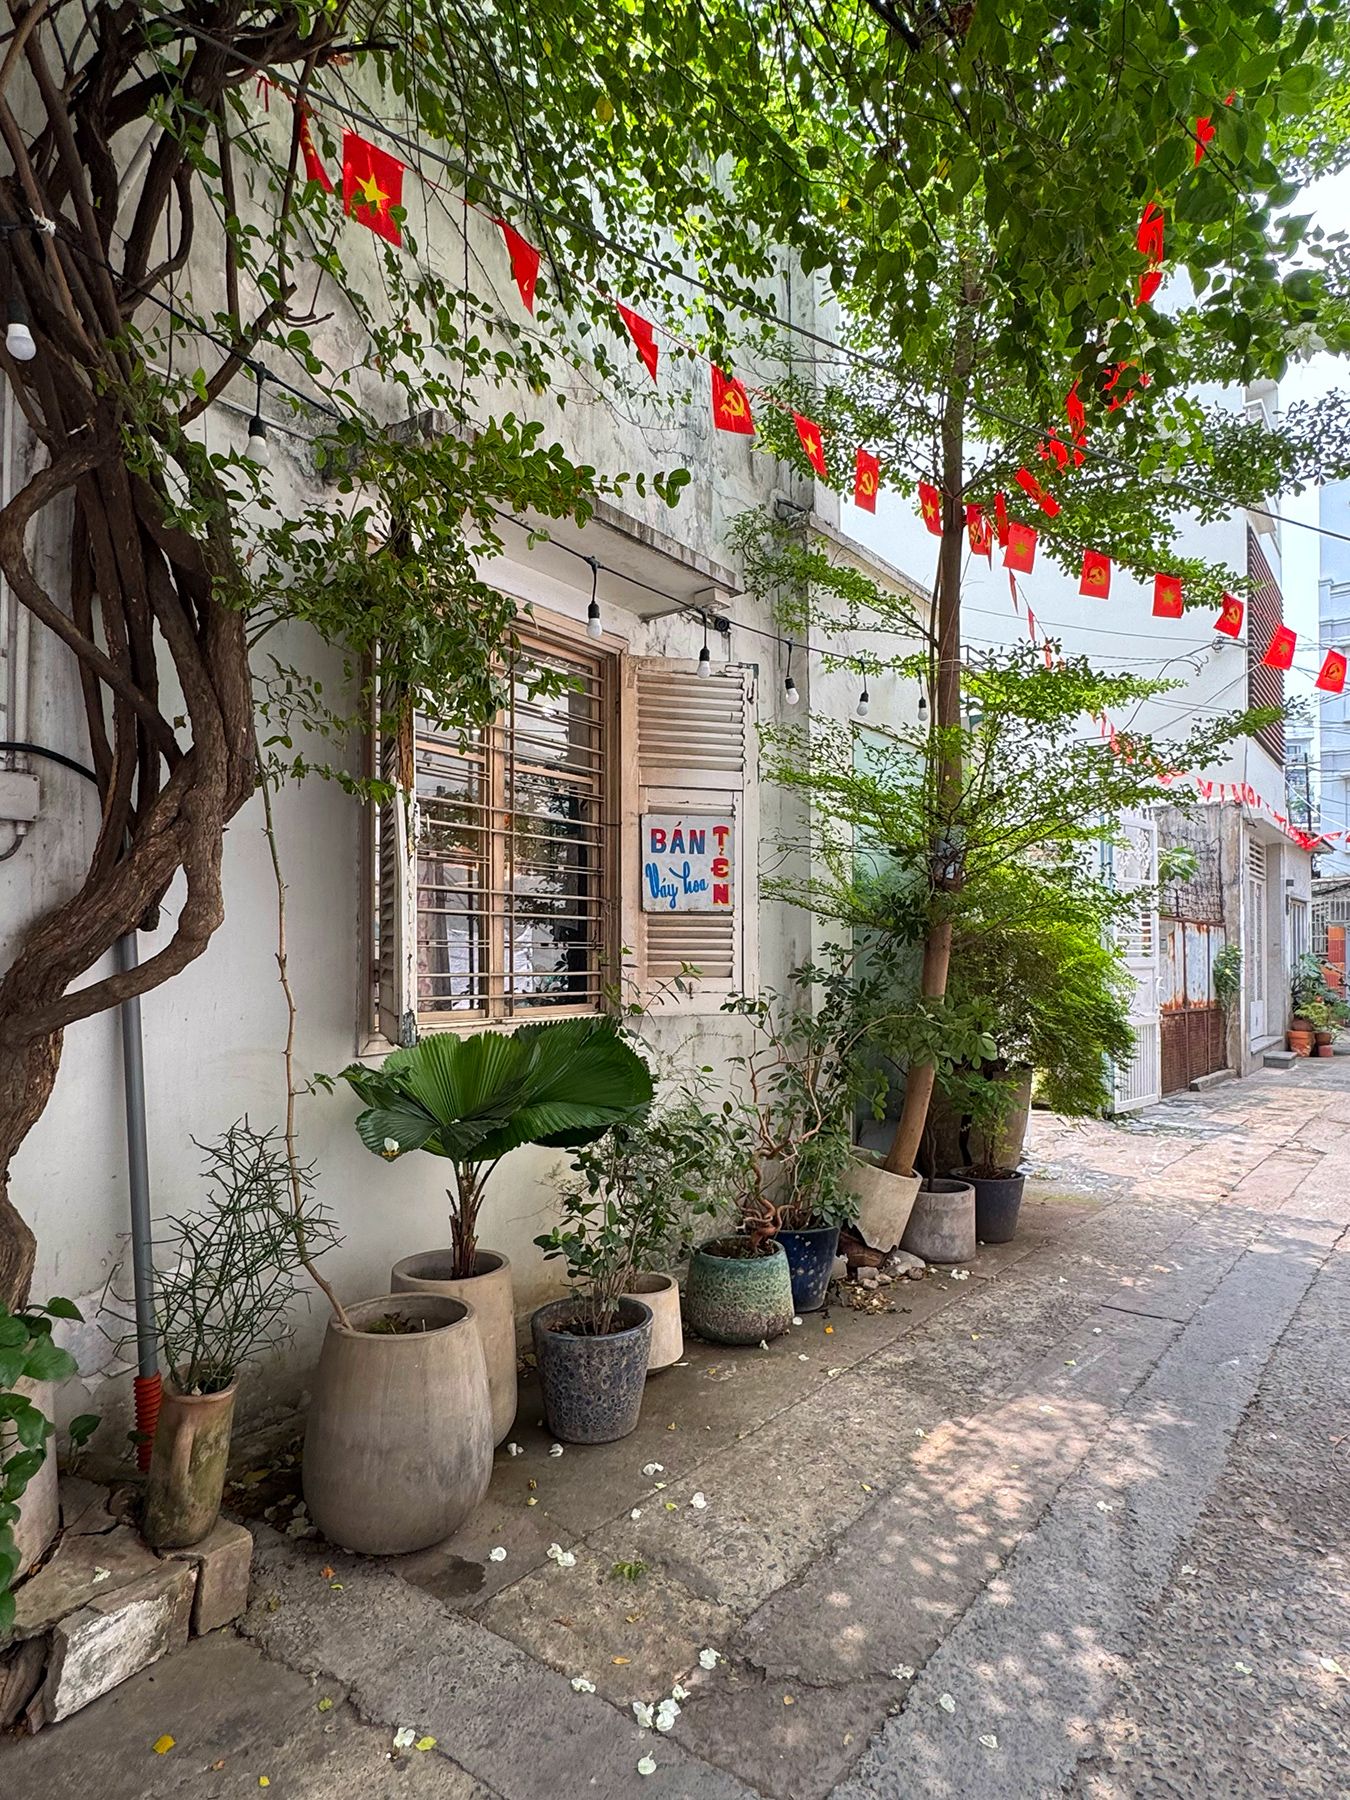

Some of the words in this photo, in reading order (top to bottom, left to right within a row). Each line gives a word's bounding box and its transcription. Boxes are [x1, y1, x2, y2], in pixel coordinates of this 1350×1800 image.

[650, 820, 706, 855] BÁN
[645, 862, 678, 909] Váy
[668, 861, 709, 894] hoa
